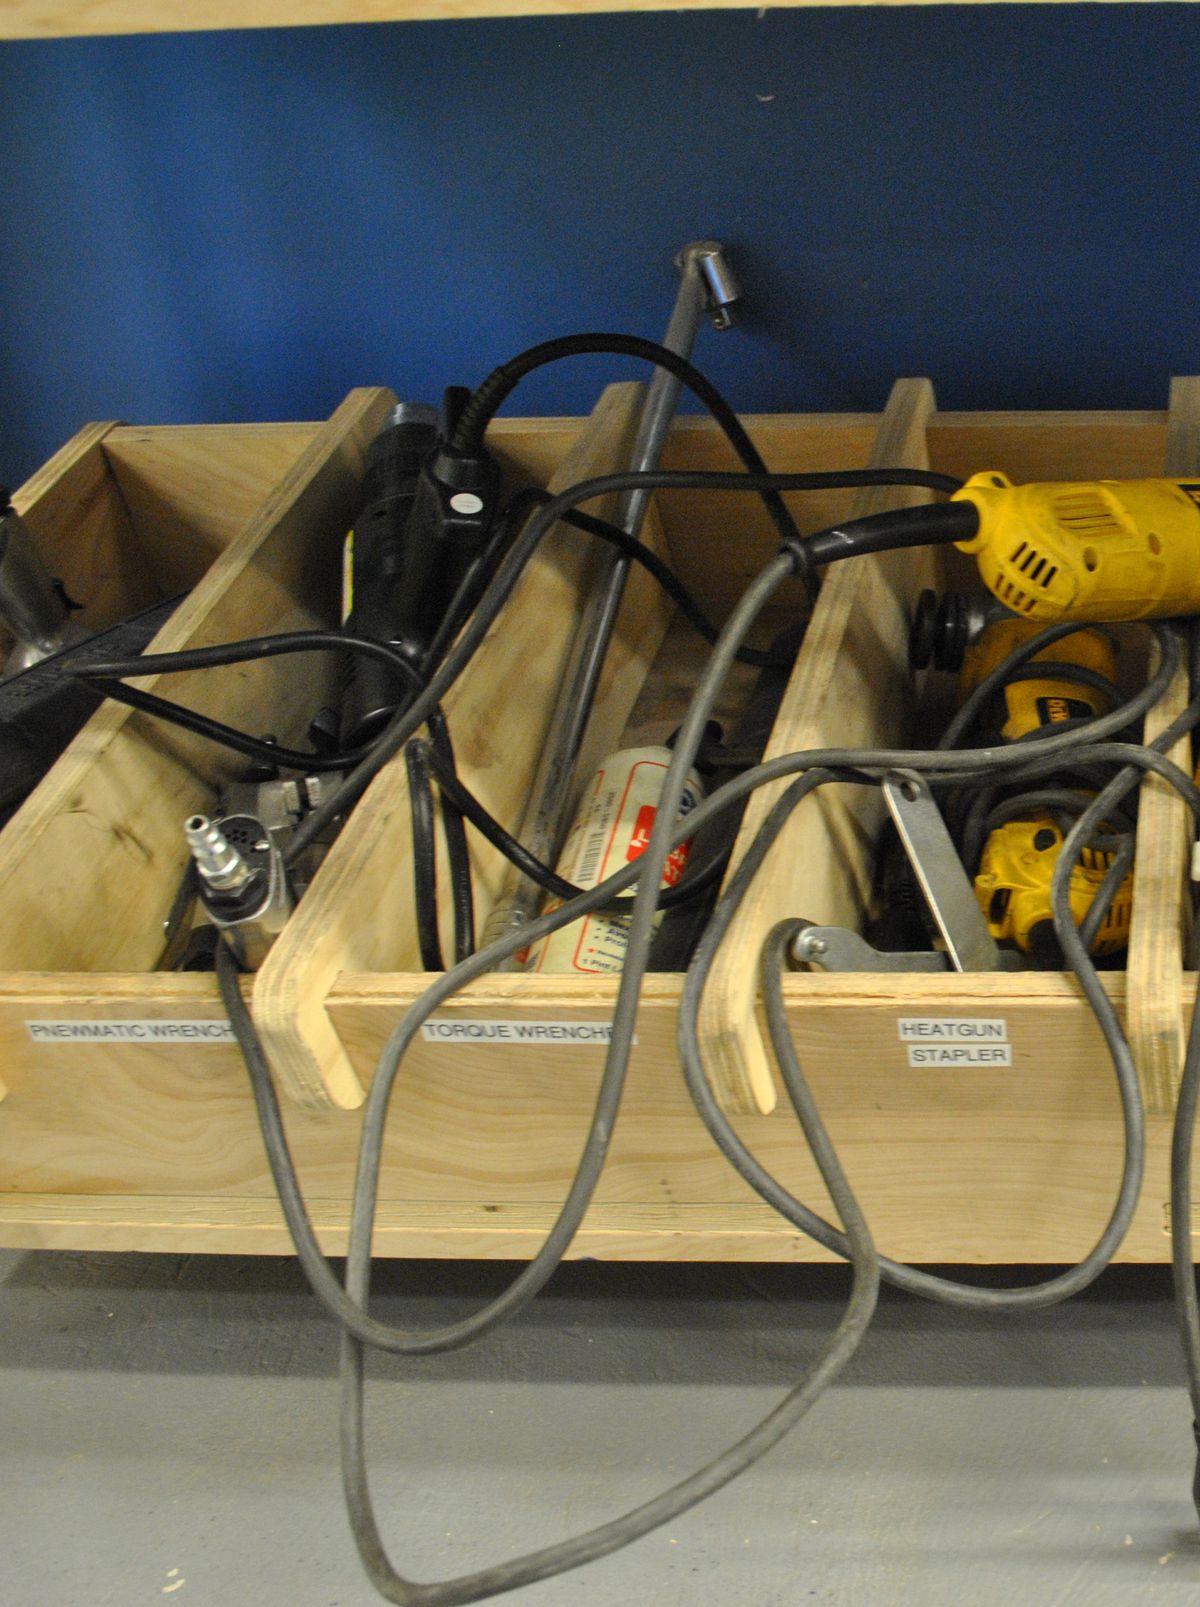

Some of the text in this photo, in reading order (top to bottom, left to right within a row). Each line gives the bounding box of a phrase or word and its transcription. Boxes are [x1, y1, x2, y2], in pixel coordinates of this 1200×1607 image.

[29, 1024, 234, 1037] PNEWMATIC WRENCH
[424, 1023, 613, 1039] TORQUE WRENCH
[901, 1023, 1003, 1037] HEATGUN
[912, 1048, 1008, 1062] STAPLER
